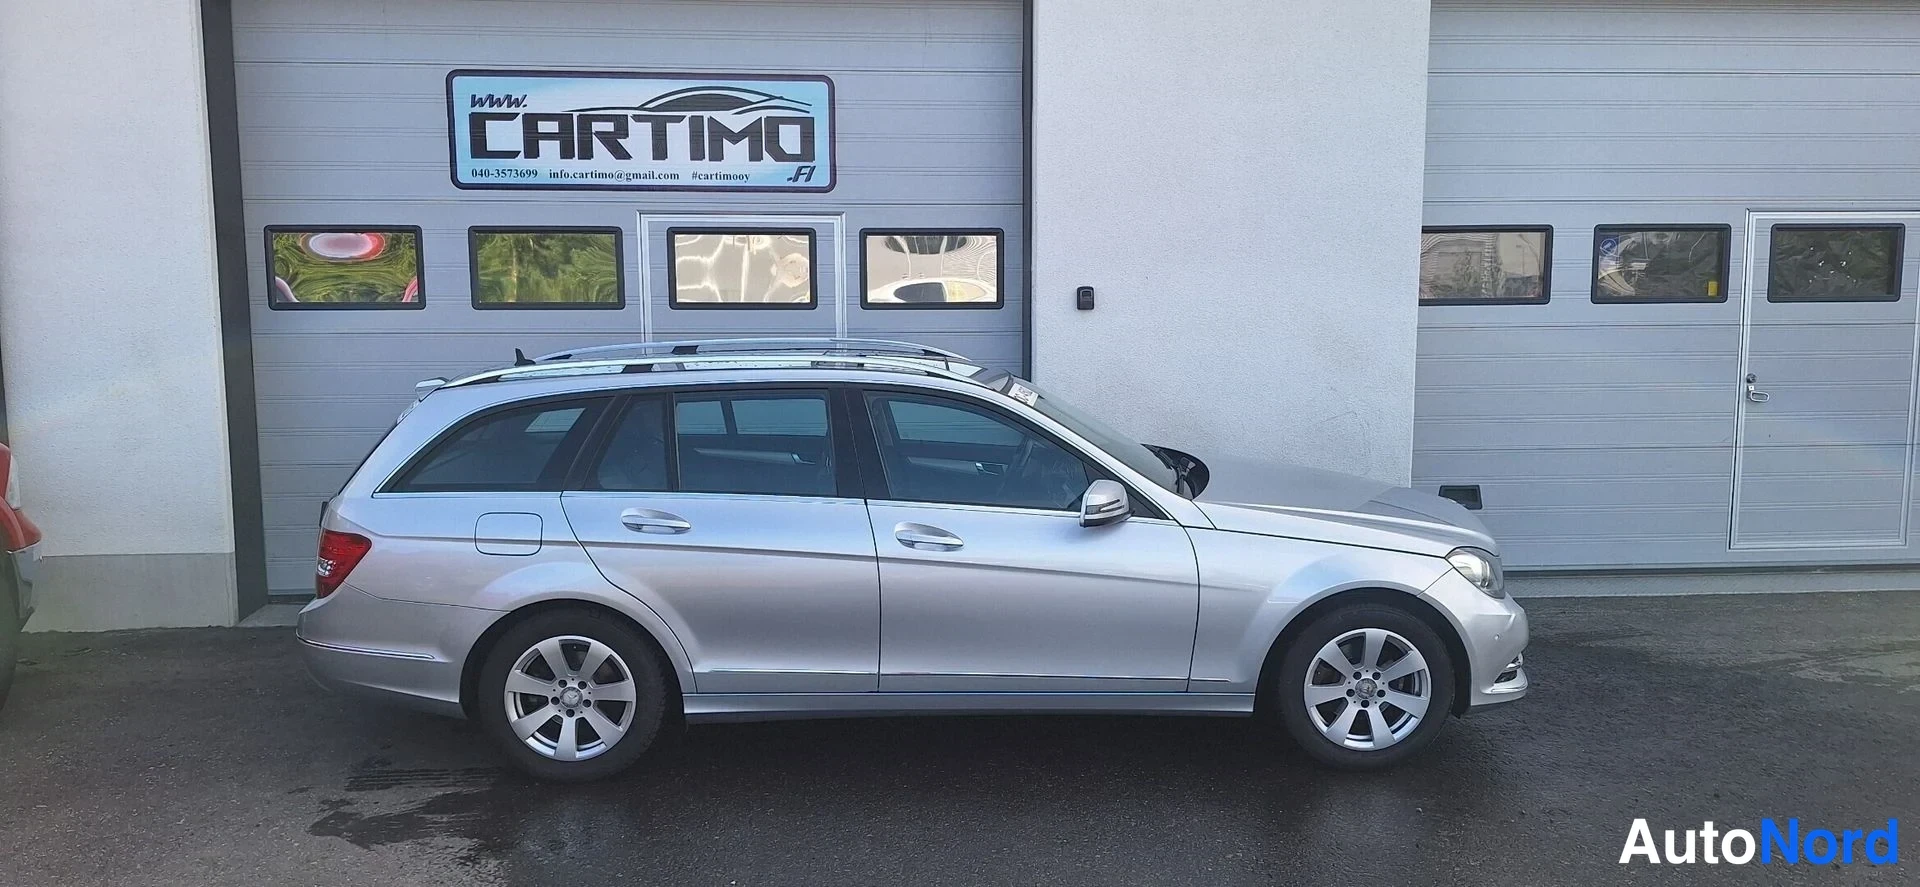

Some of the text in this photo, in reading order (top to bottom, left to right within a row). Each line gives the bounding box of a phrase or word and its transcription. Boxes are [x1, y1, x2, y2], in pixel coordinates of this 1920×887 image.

[469, 112, 815, 162] CARTIMO
[471, 168, 750, 183] 040-3573699 info.cartimo@gmail.com #cartimooy
